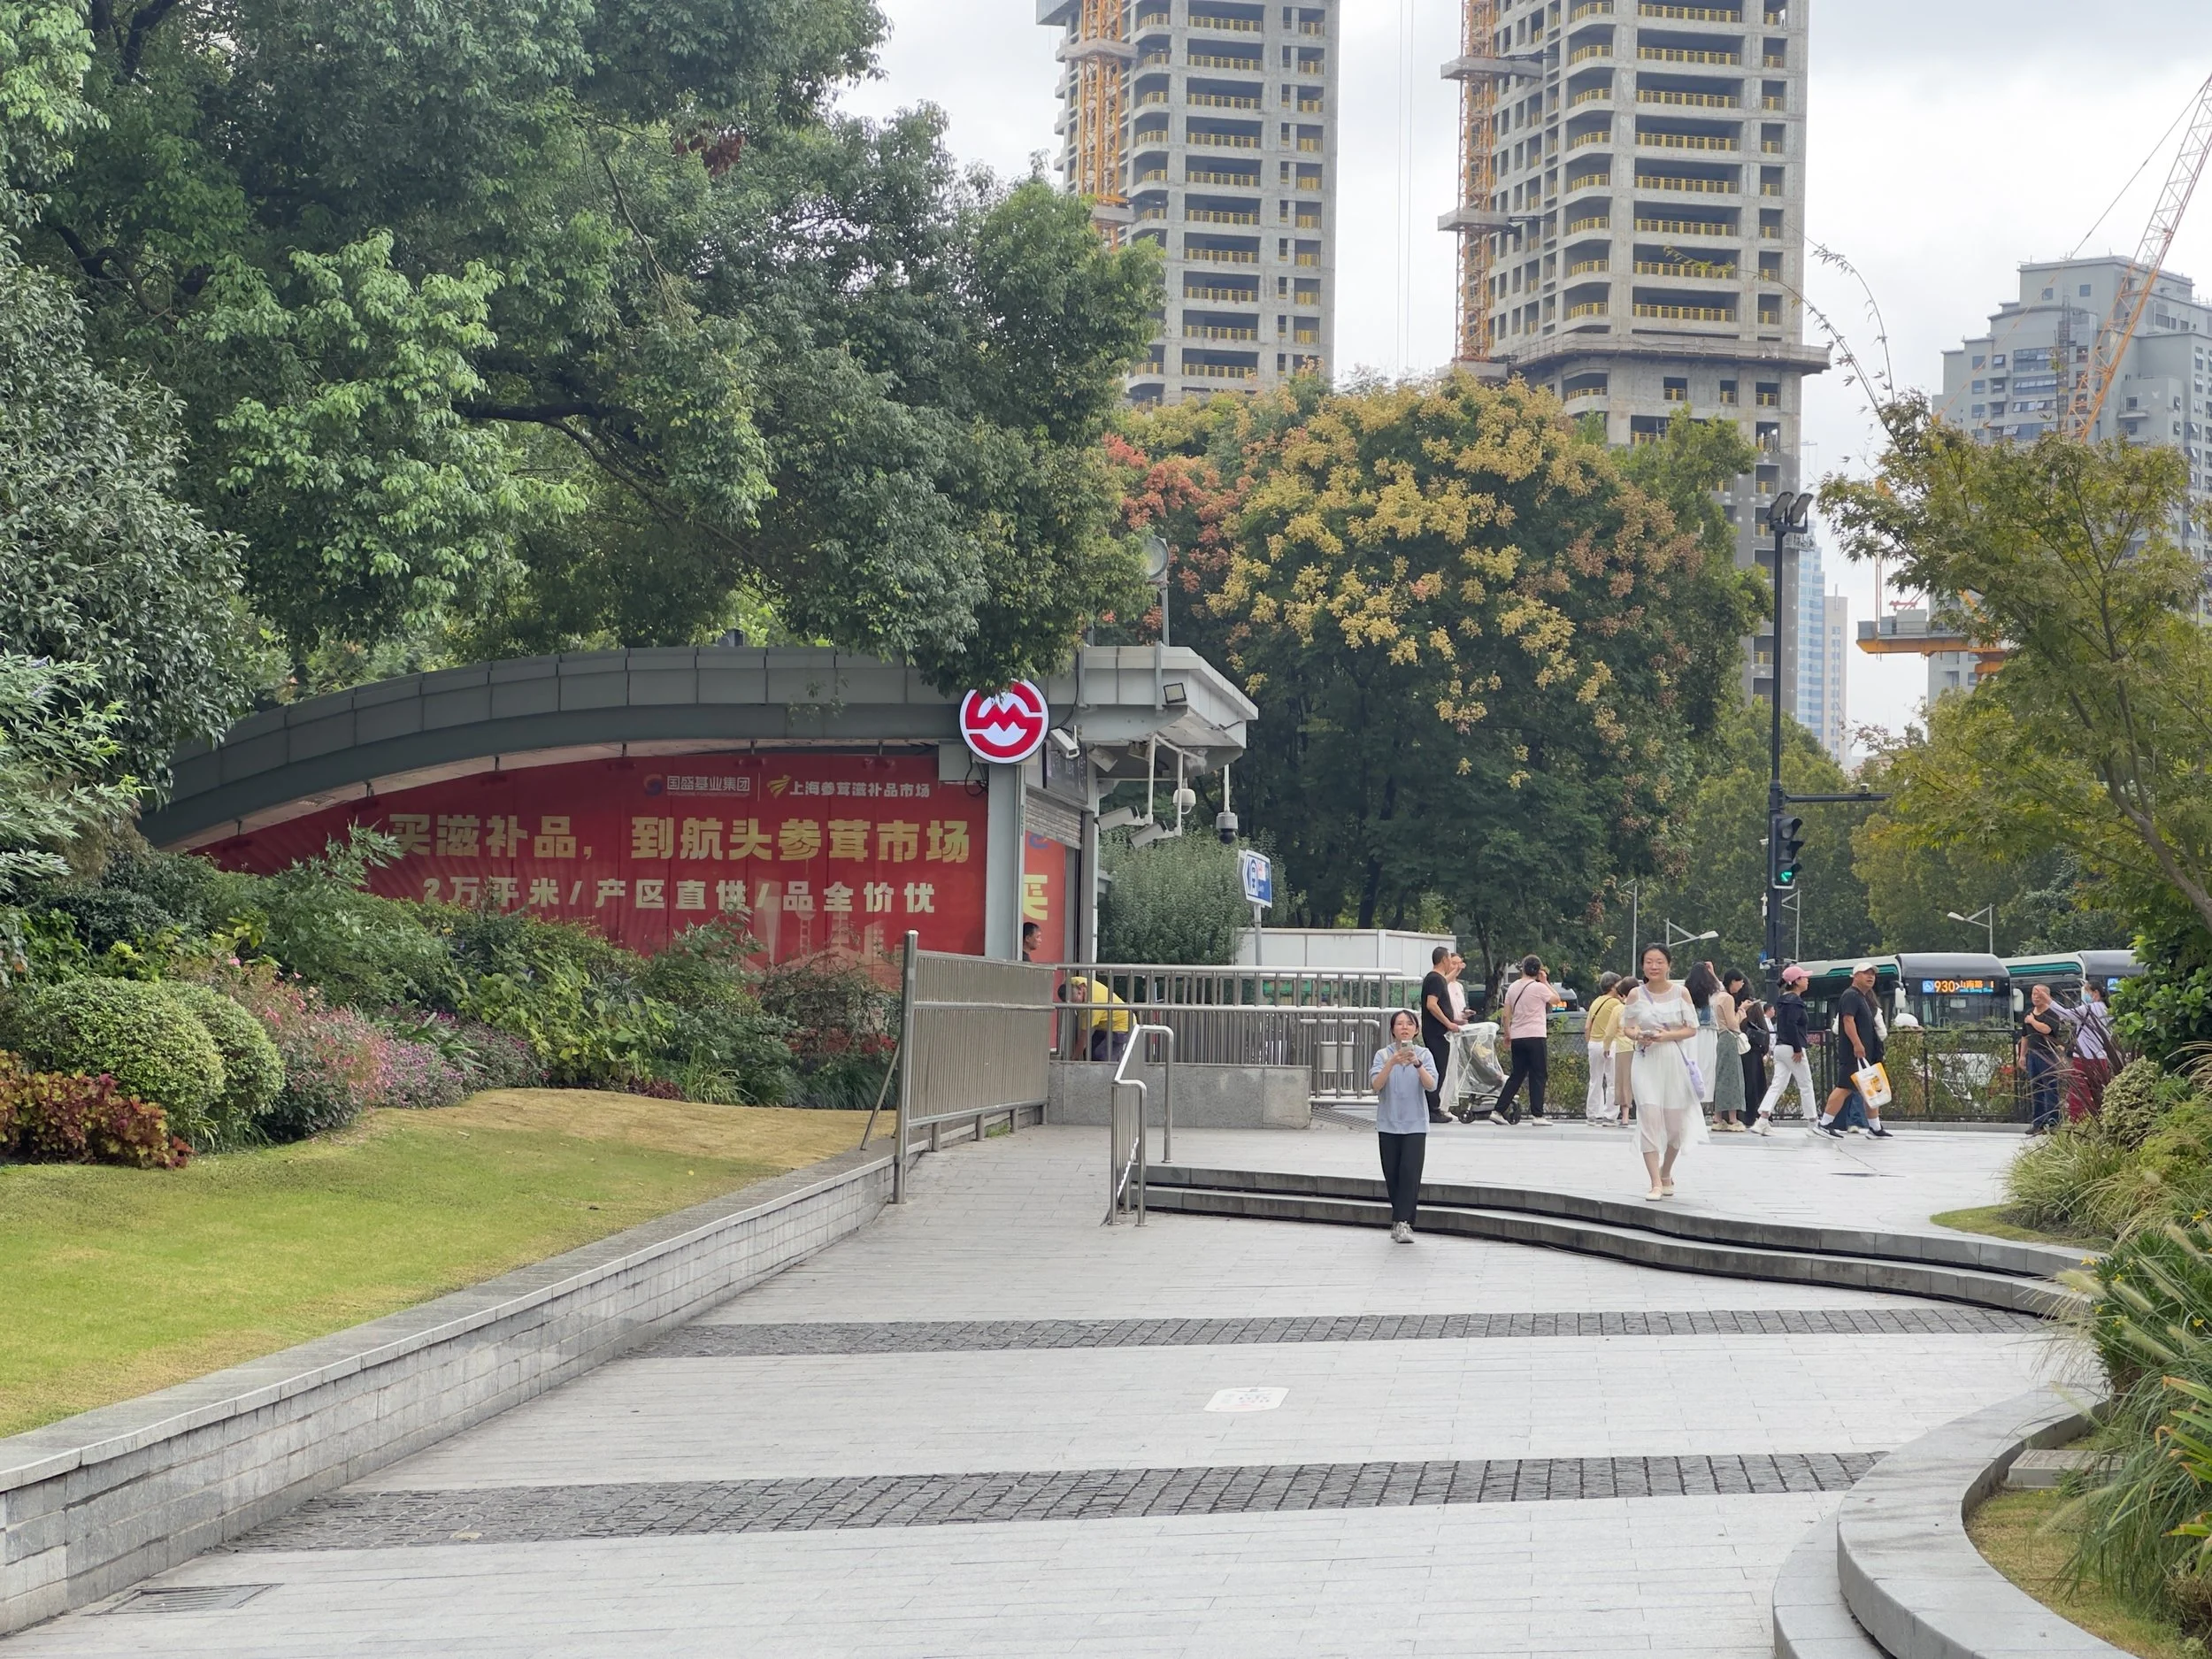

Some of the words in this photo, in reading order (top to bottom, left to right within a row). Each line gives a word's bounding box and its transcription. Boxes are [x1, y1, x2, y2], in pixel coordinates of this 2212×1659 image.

[667, 775, 750, 791] 国盛基业集团
[789, 781, 930, 797] 上海参茸滋补品市场
[1934, 980, 1955, 992] 930
